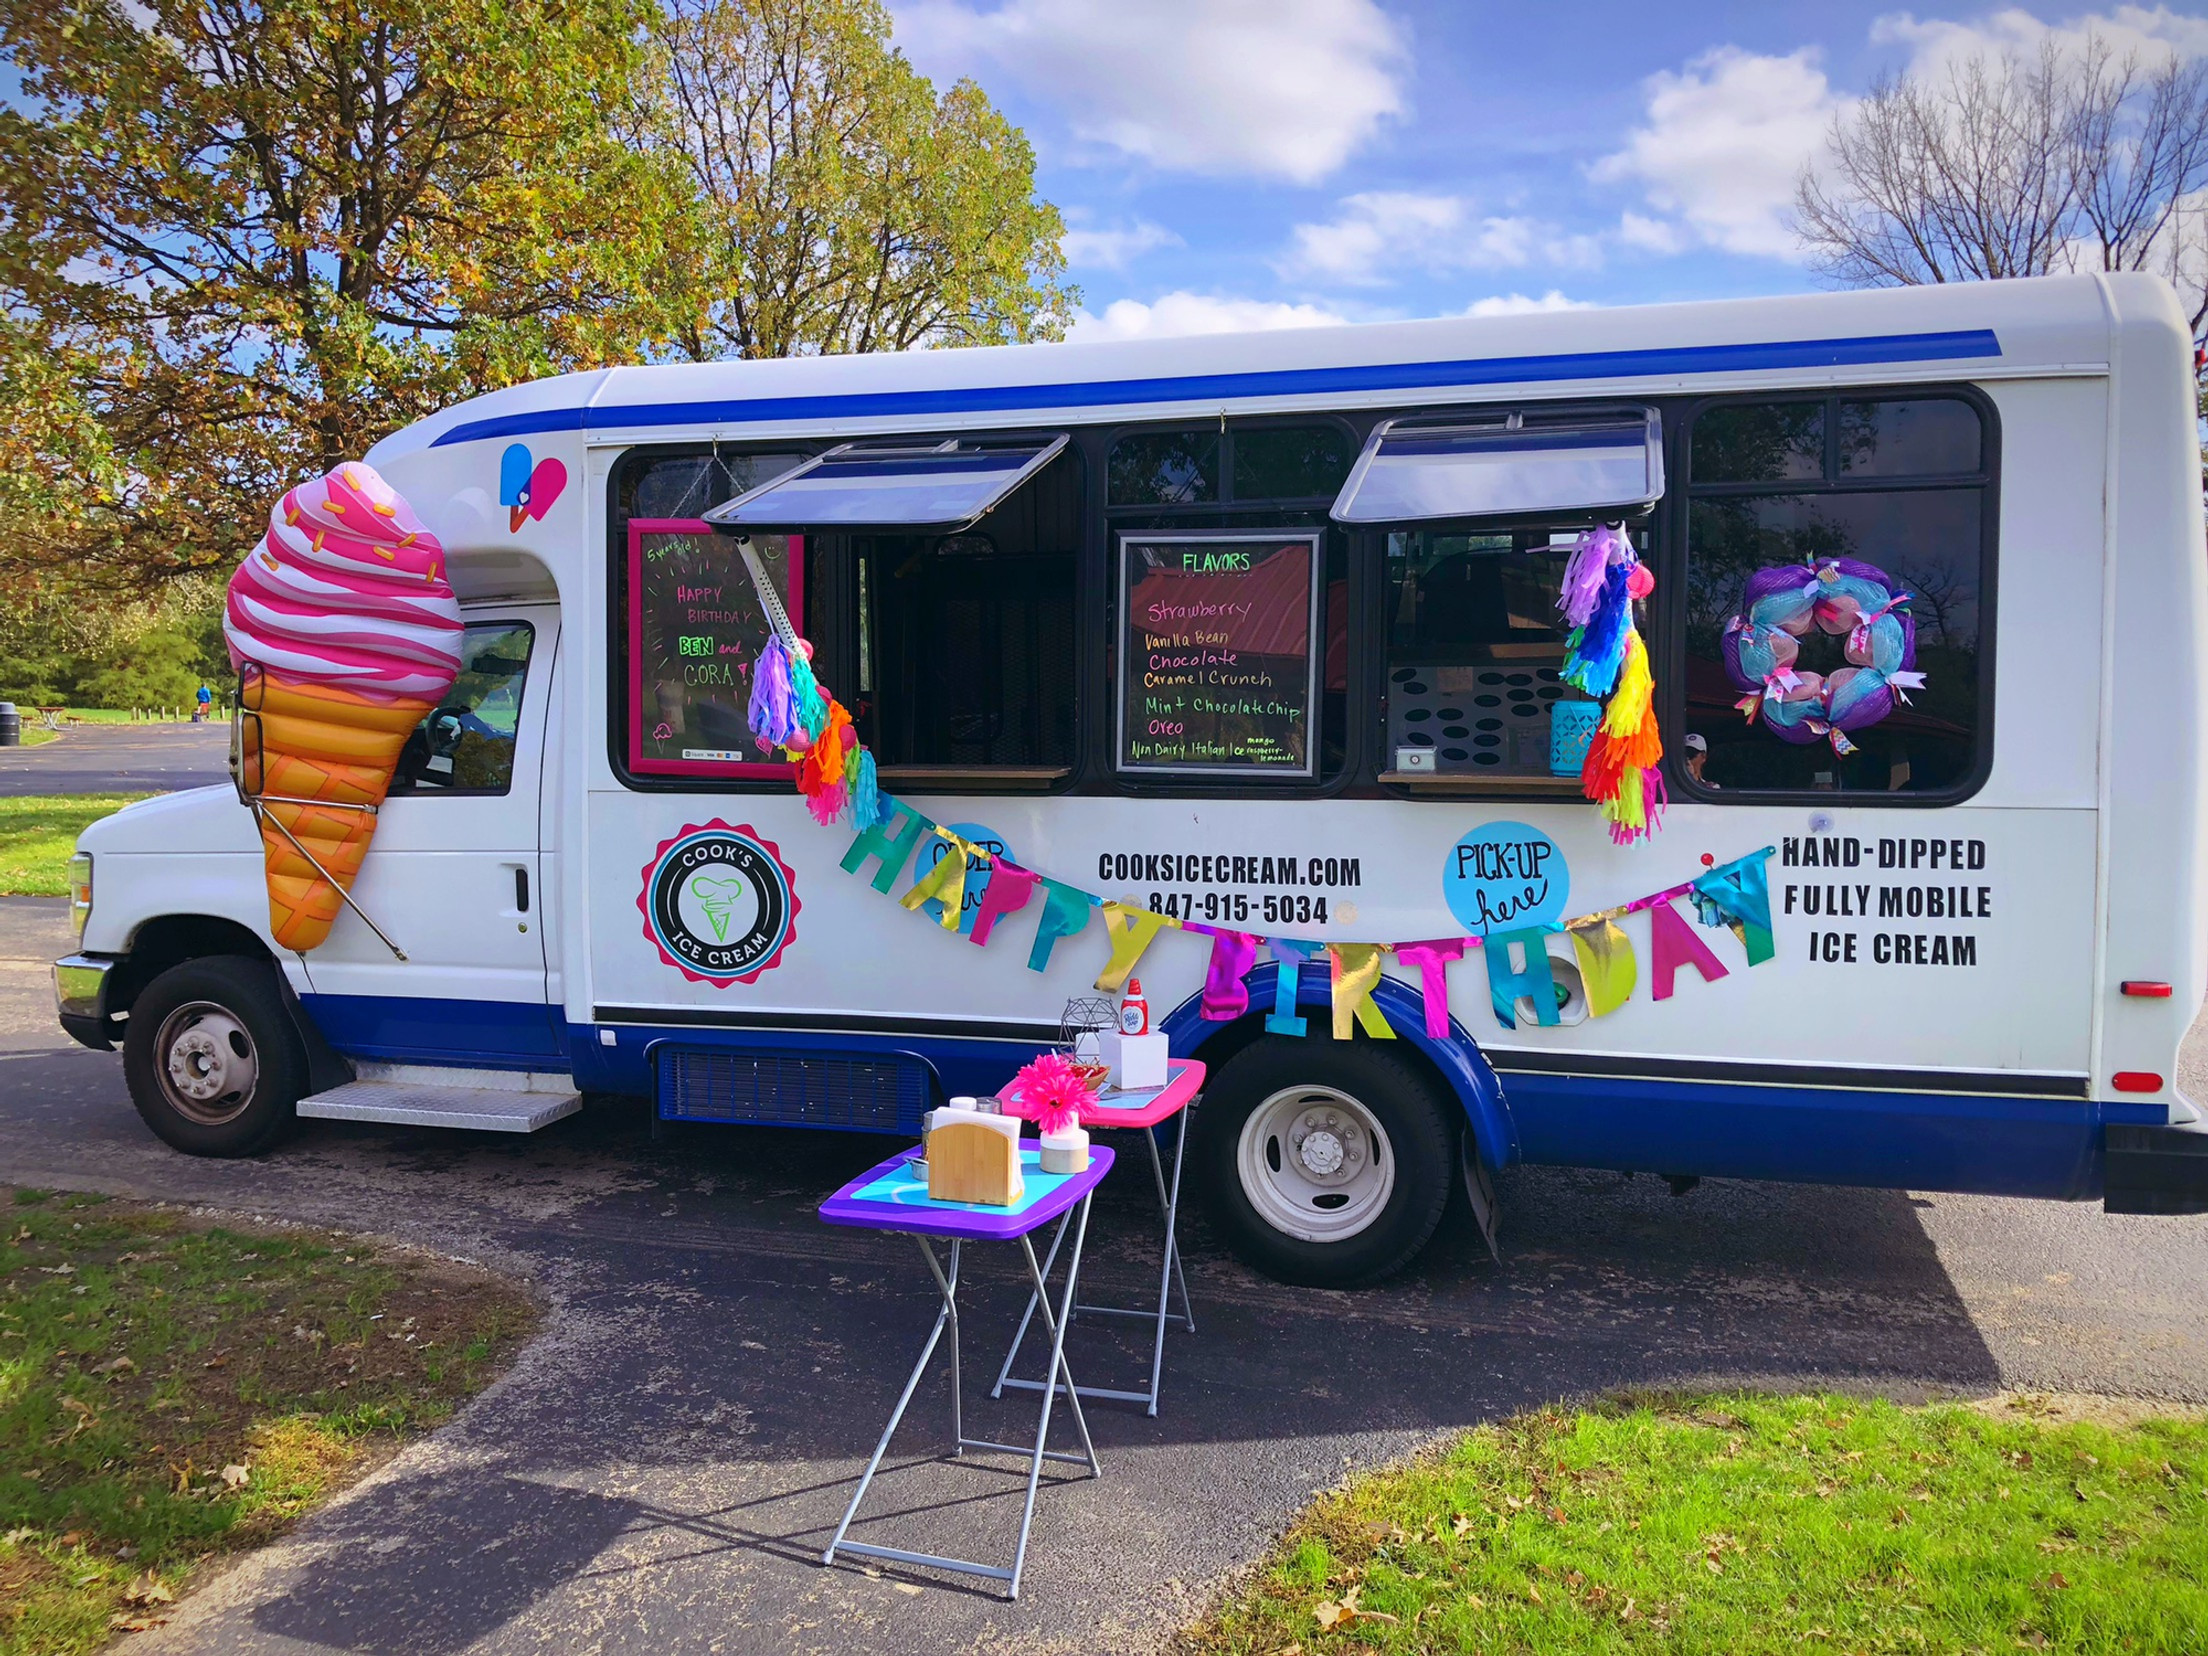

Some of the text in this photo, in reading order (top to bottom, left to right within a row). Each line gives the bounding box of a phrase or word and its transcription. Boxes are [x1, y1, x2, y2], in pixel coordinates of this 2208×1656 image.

[1183, 553, 1250, 573] FLAVORS
[677, 584, 722, 604] HAPPY
[687, 608, 752, 624] BIRTHDAY
[1148, 599, 1252, 623] Strawberry
[679, 636, 742, 656] BEN and
[1145, 630, 1229, 651] Vanilla Bean
[1149, 649, 1238, 671] Chocolate
[1143, 670, 1272, 688] Caramel Crunch
[1145, 696, 1300, 724] Mint Chocolate Chip
[1148, 719, 1184, 736] Oreo
[1131, 740, 1246, 760] Non Dairy Italian Ice
[682, 844, 753, 868] COOK'S
[1456, 840, 1551, 881] PICK-UP
[1782, 836, 1986, 870] HAND-DIPPED
[1099, 852, 1361, 887] COOKSICECREAM.COM
[1149, 892, 1329, 924] 847-915-5034
[1471, 878, 1548, 934] here
[1784, 885, 1992, 918] FULLY MOBILE
[839, 788, 1776, 1041] HAPPY BIRTHDAY
[671, 930, 768, 965] ICE CREAM
[1809, 931, 1977, 966] ICE CREAM
